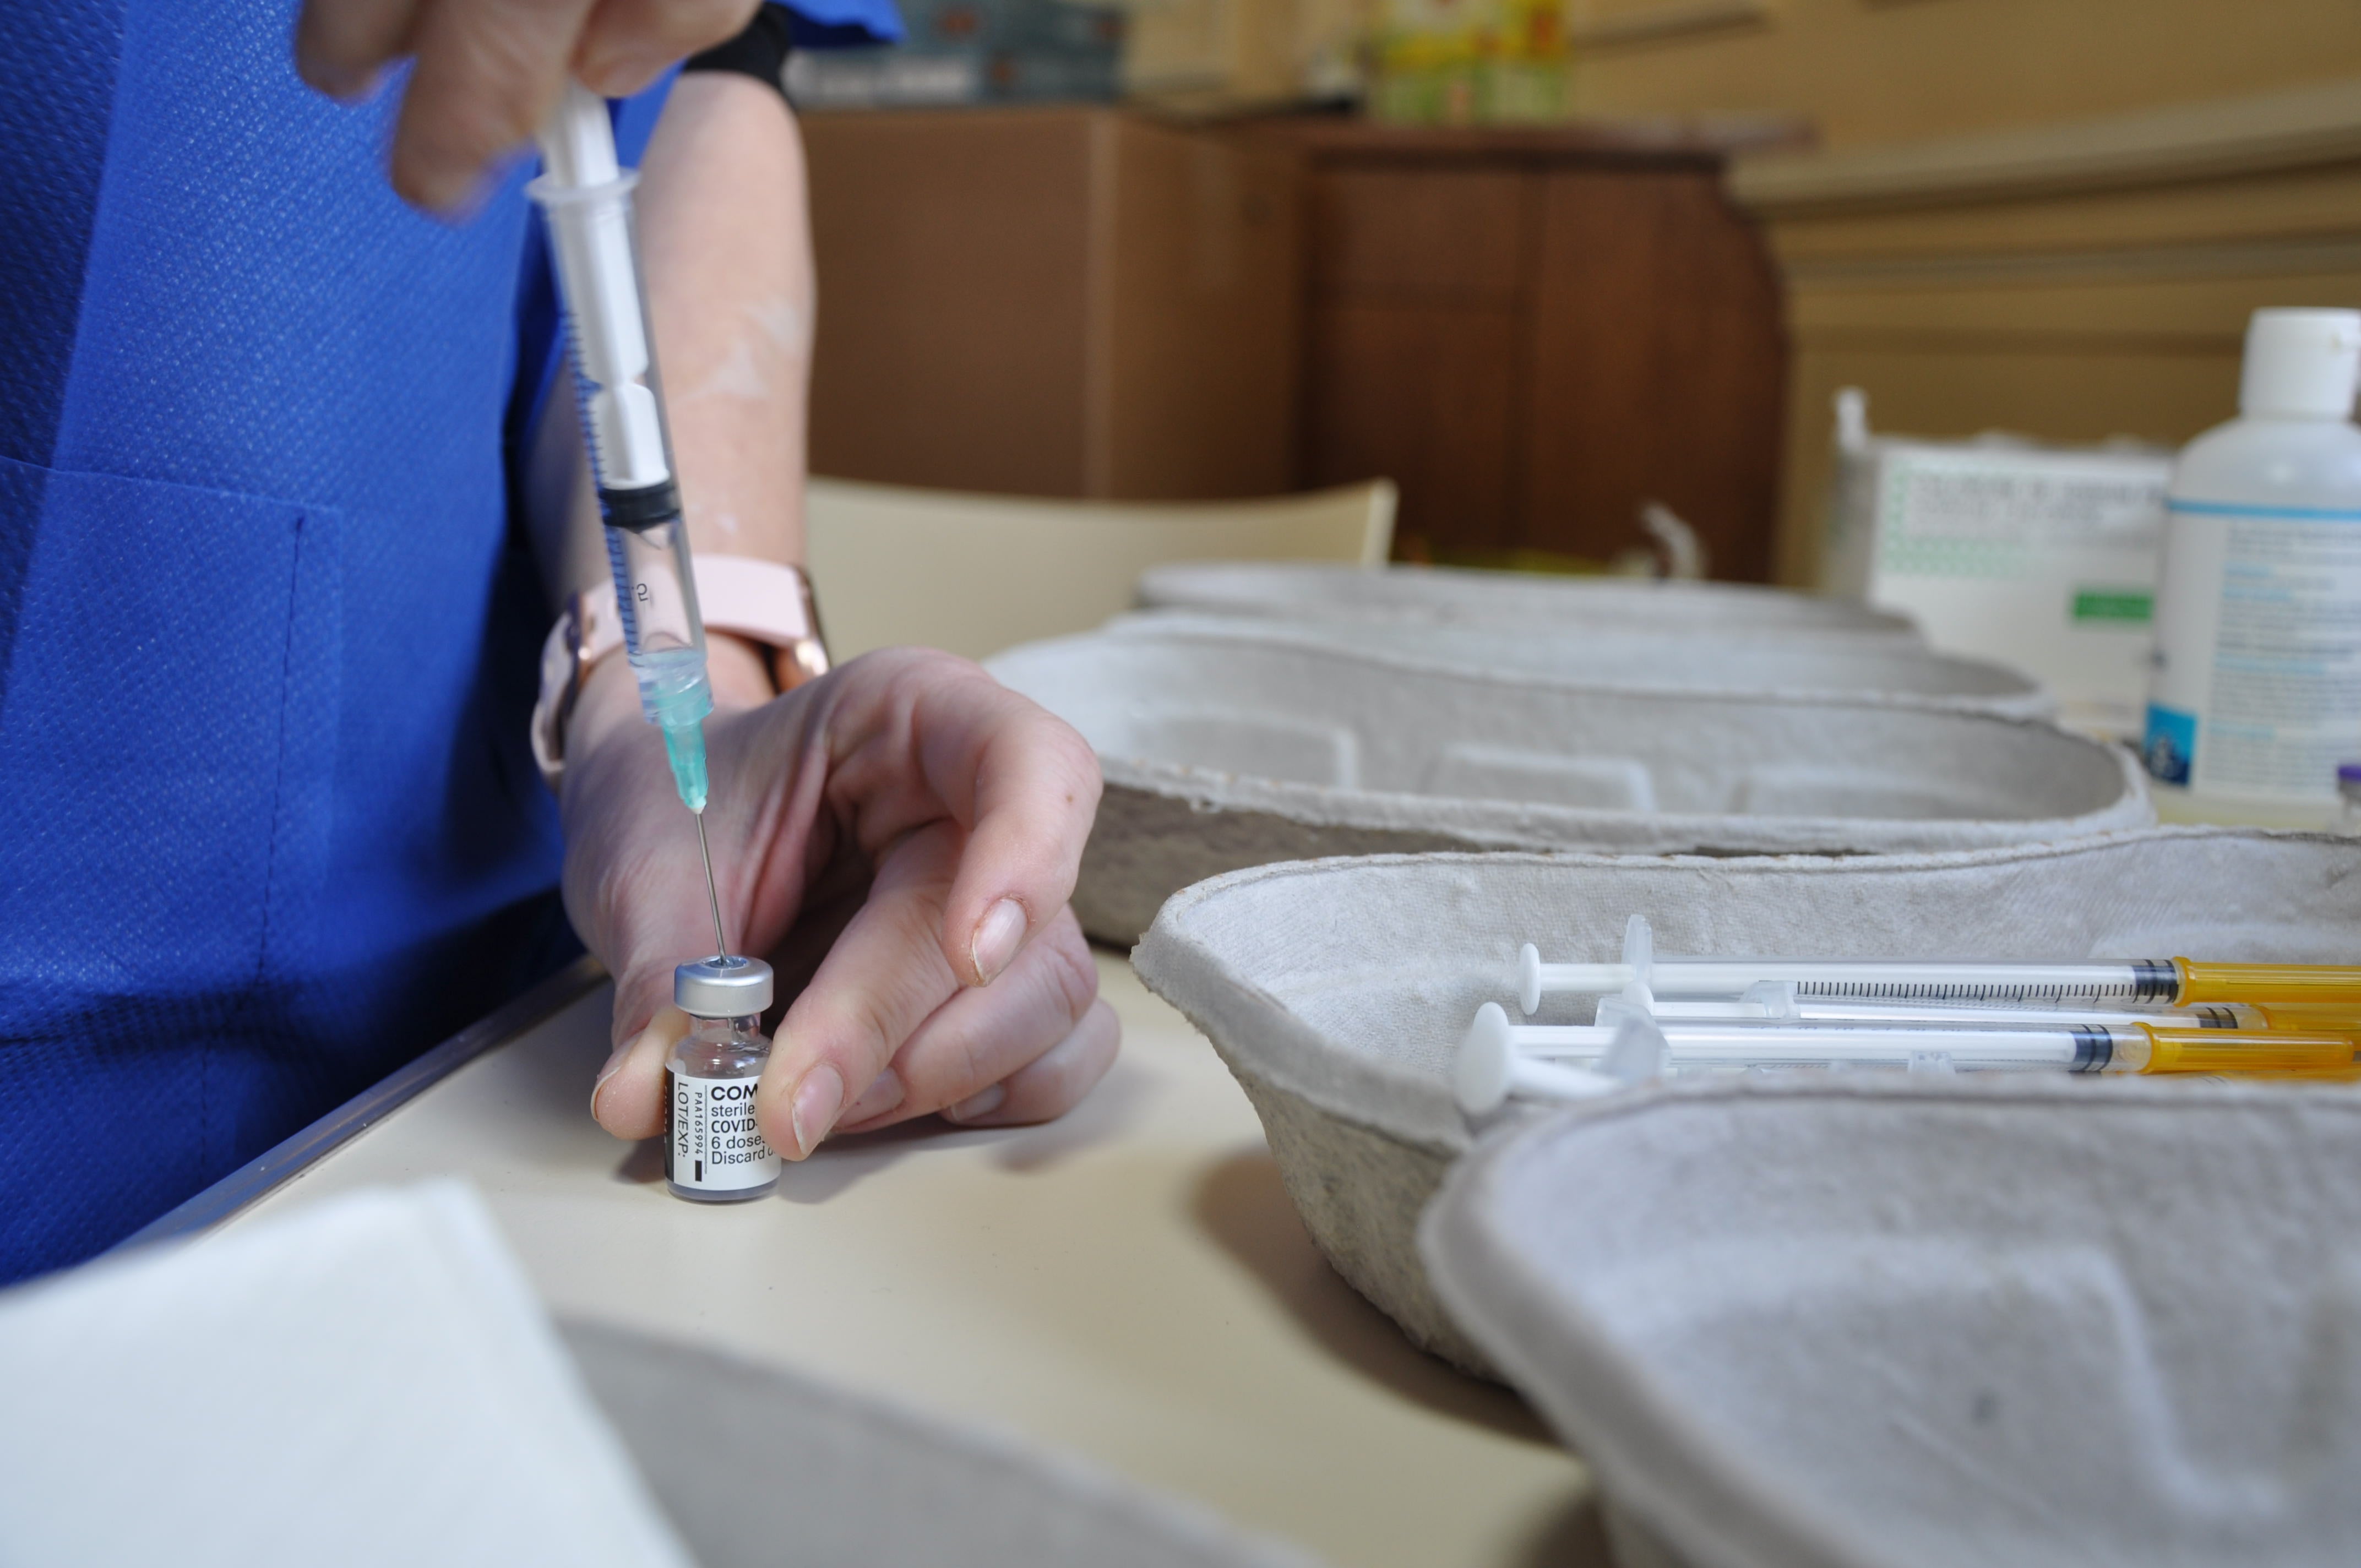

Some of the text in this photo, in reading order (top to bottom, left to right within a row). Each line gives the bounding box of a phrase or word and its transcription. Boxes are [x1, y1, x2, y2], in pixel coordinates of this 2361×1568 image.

[711, 1102, 755, 1117] sterile
[678, 1082, 689, 1157] LOT/EXP:
[695, 1092, 703, 1155] PAA165994
[711, 1136, 721, 1149] 6
[712, 1145, 765, 1164] Discard
